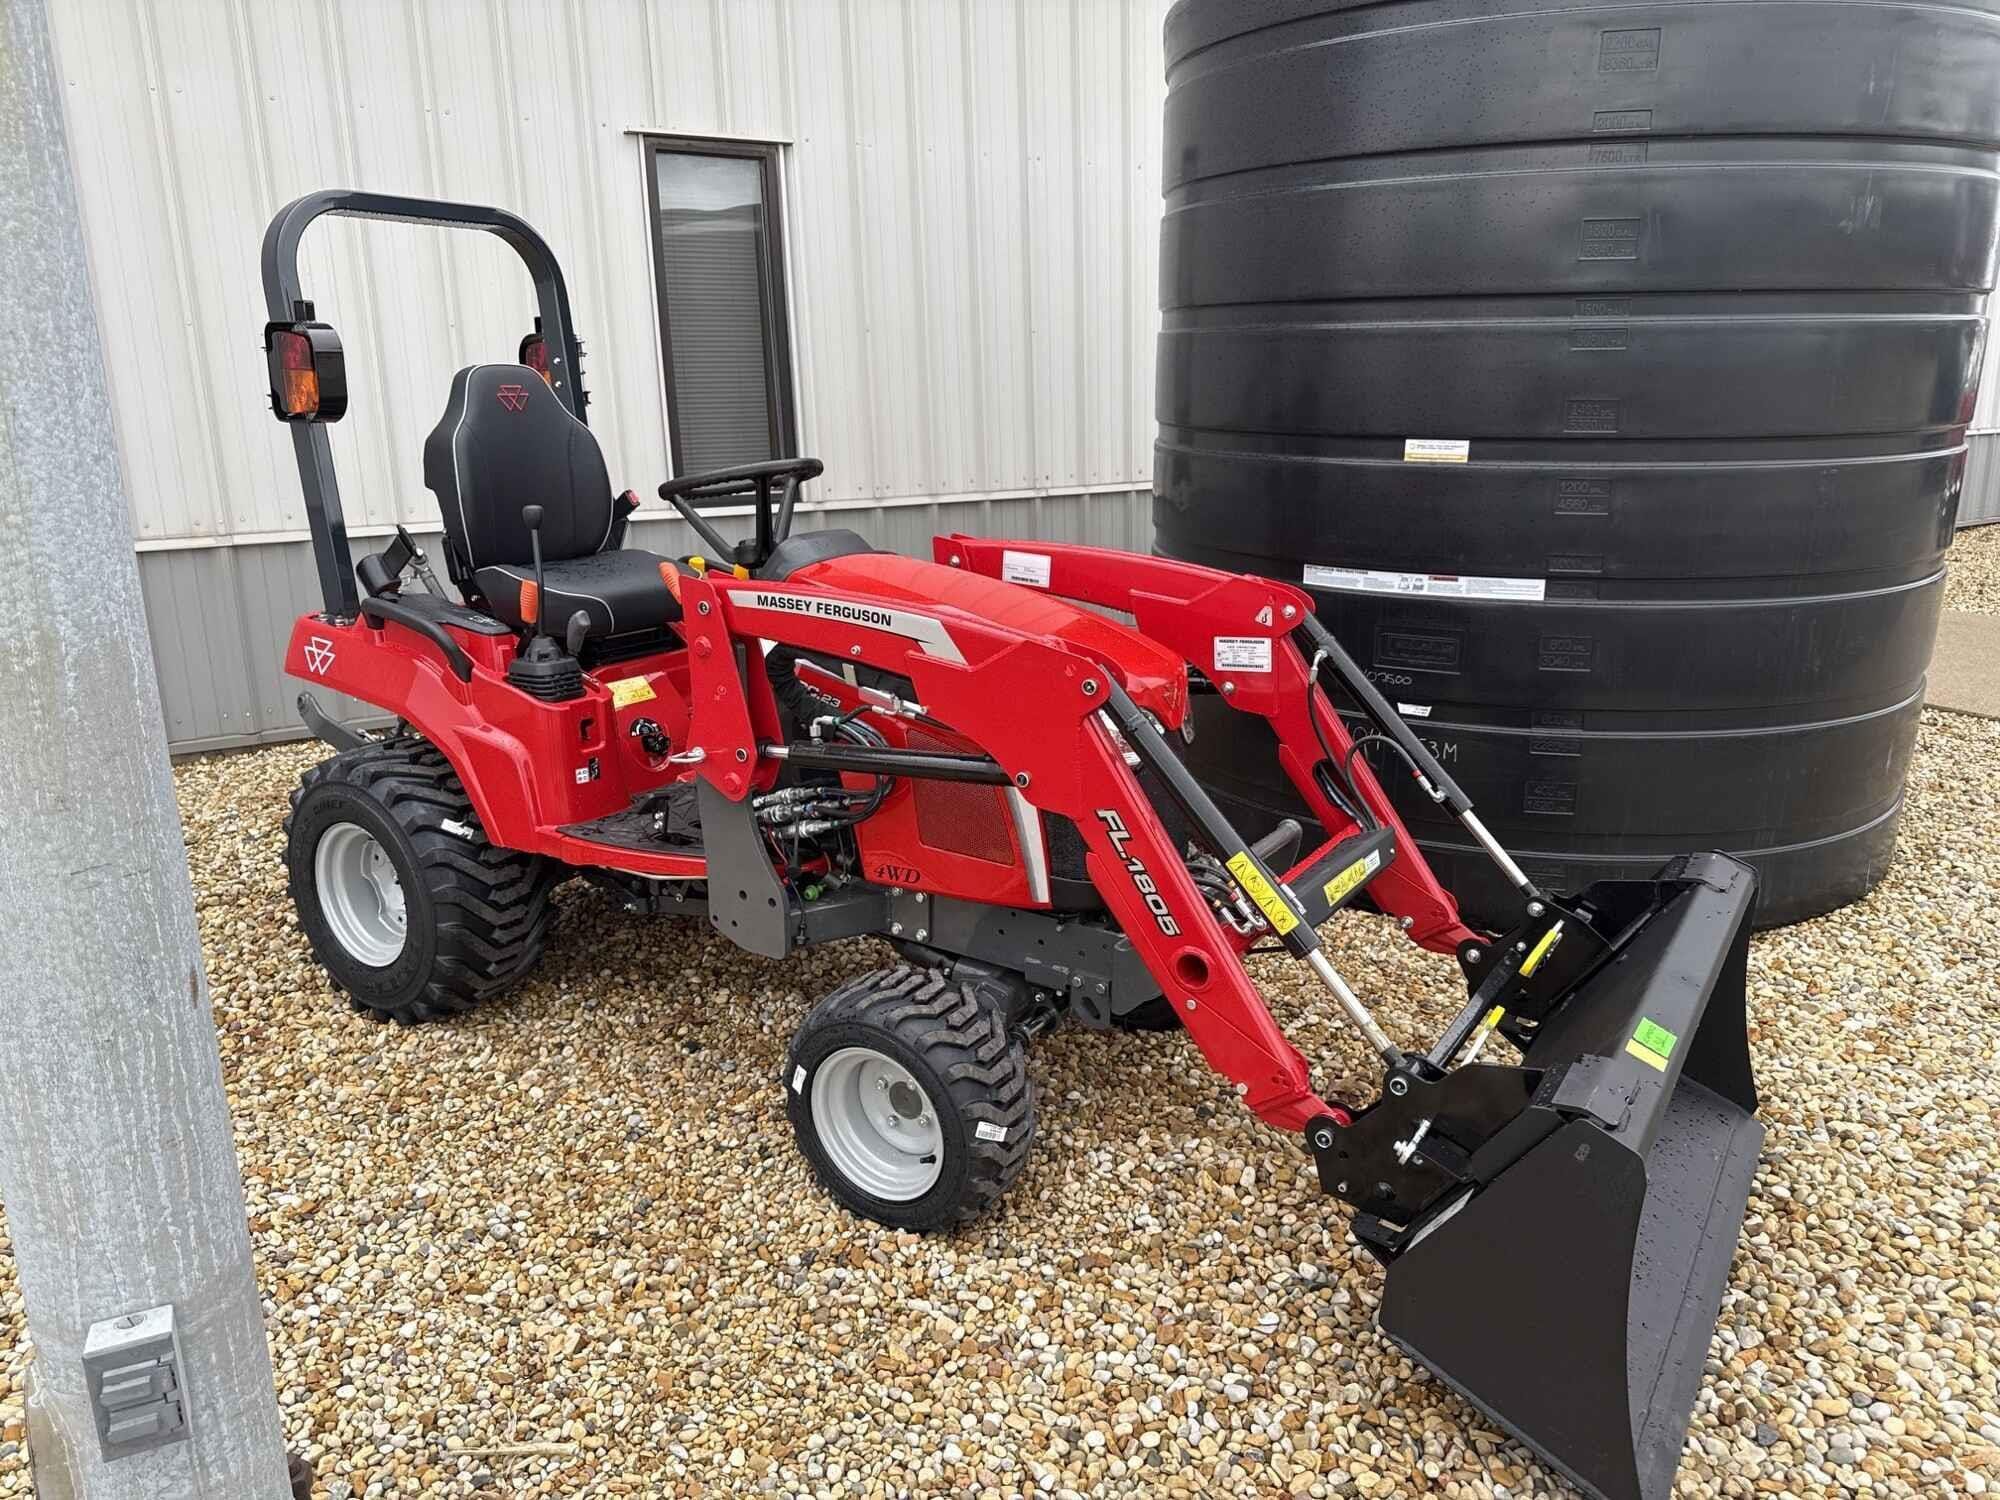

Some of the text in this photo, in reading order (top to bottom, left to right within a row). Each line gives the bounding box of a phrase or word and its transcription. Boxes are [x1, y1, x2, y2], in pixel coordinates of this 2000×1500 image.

[757, 594, 892, 627] MASSEY FERGUSON
[874, 864, 921, 884] 4WD
[1095, 808, 1181, 936] FL.1805
